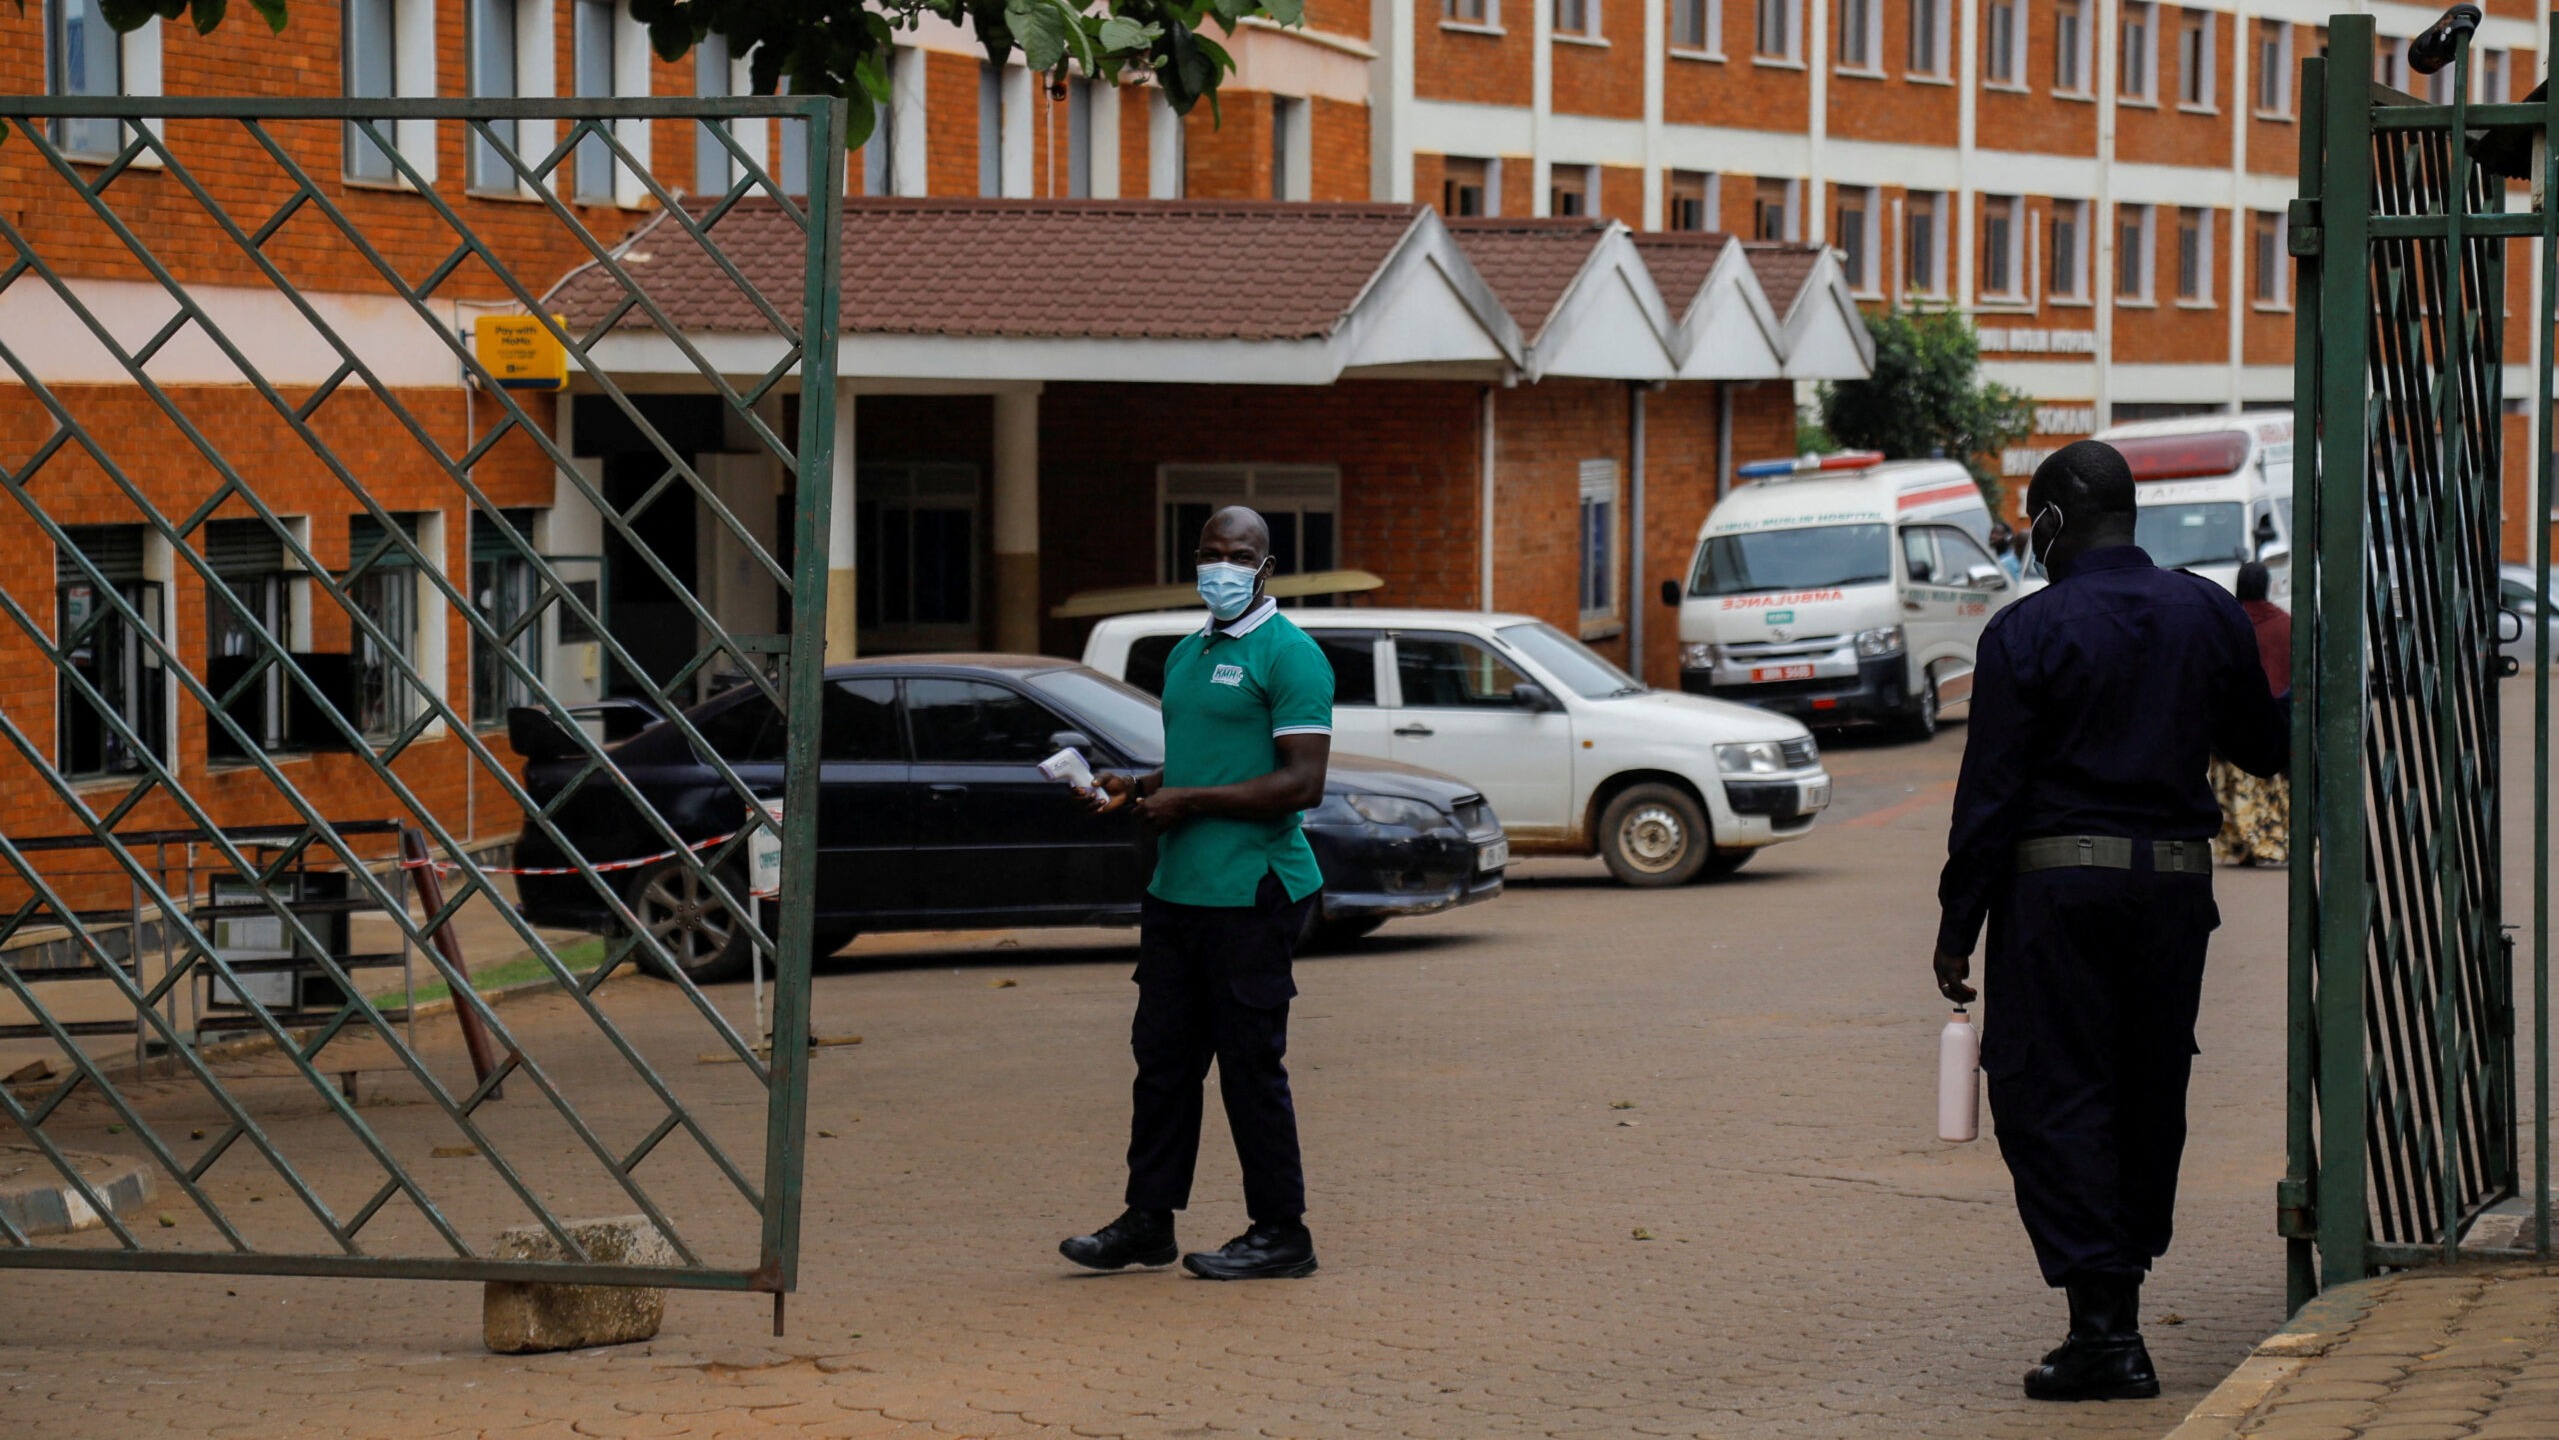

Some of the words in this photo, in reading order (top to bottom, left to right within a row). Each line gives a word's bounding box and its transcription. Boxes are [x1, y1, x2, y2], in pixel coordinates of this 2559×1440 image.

[495, 326, 512, 336] Pay
[516, 326, 537, 334] with
[501, 337, 531, 345] MoMo
